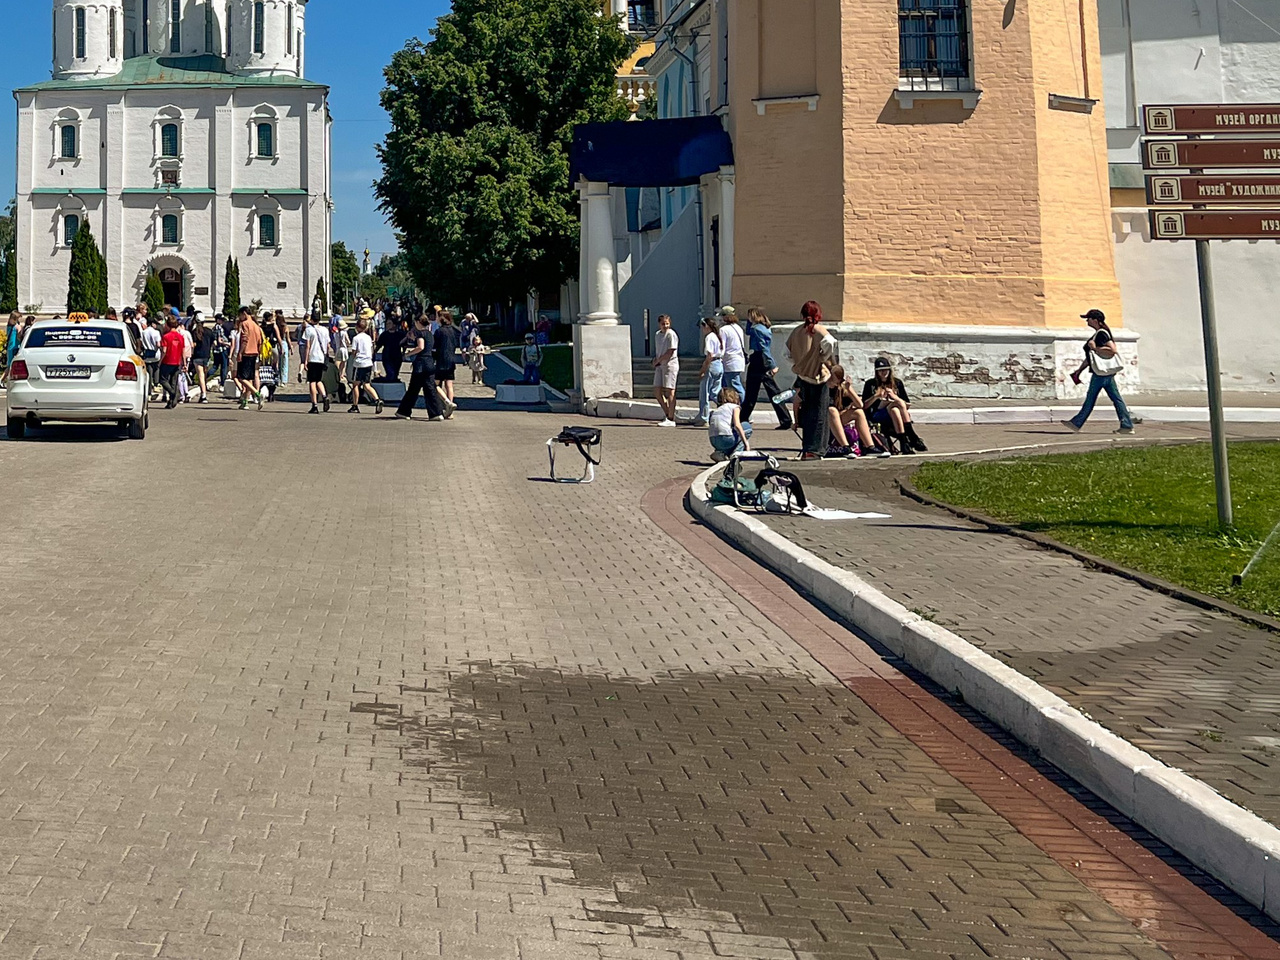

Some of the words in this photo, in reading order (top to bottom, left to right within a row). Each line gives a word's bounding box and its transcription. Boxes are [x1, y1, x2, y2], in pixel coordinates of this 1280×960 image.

[1215, 112, 1246, 125] МУЗЕЙ
[1249, 113, 1280, 125] ОРГАН
[1198, 183, 1225, 196] МУЗЕЙ
